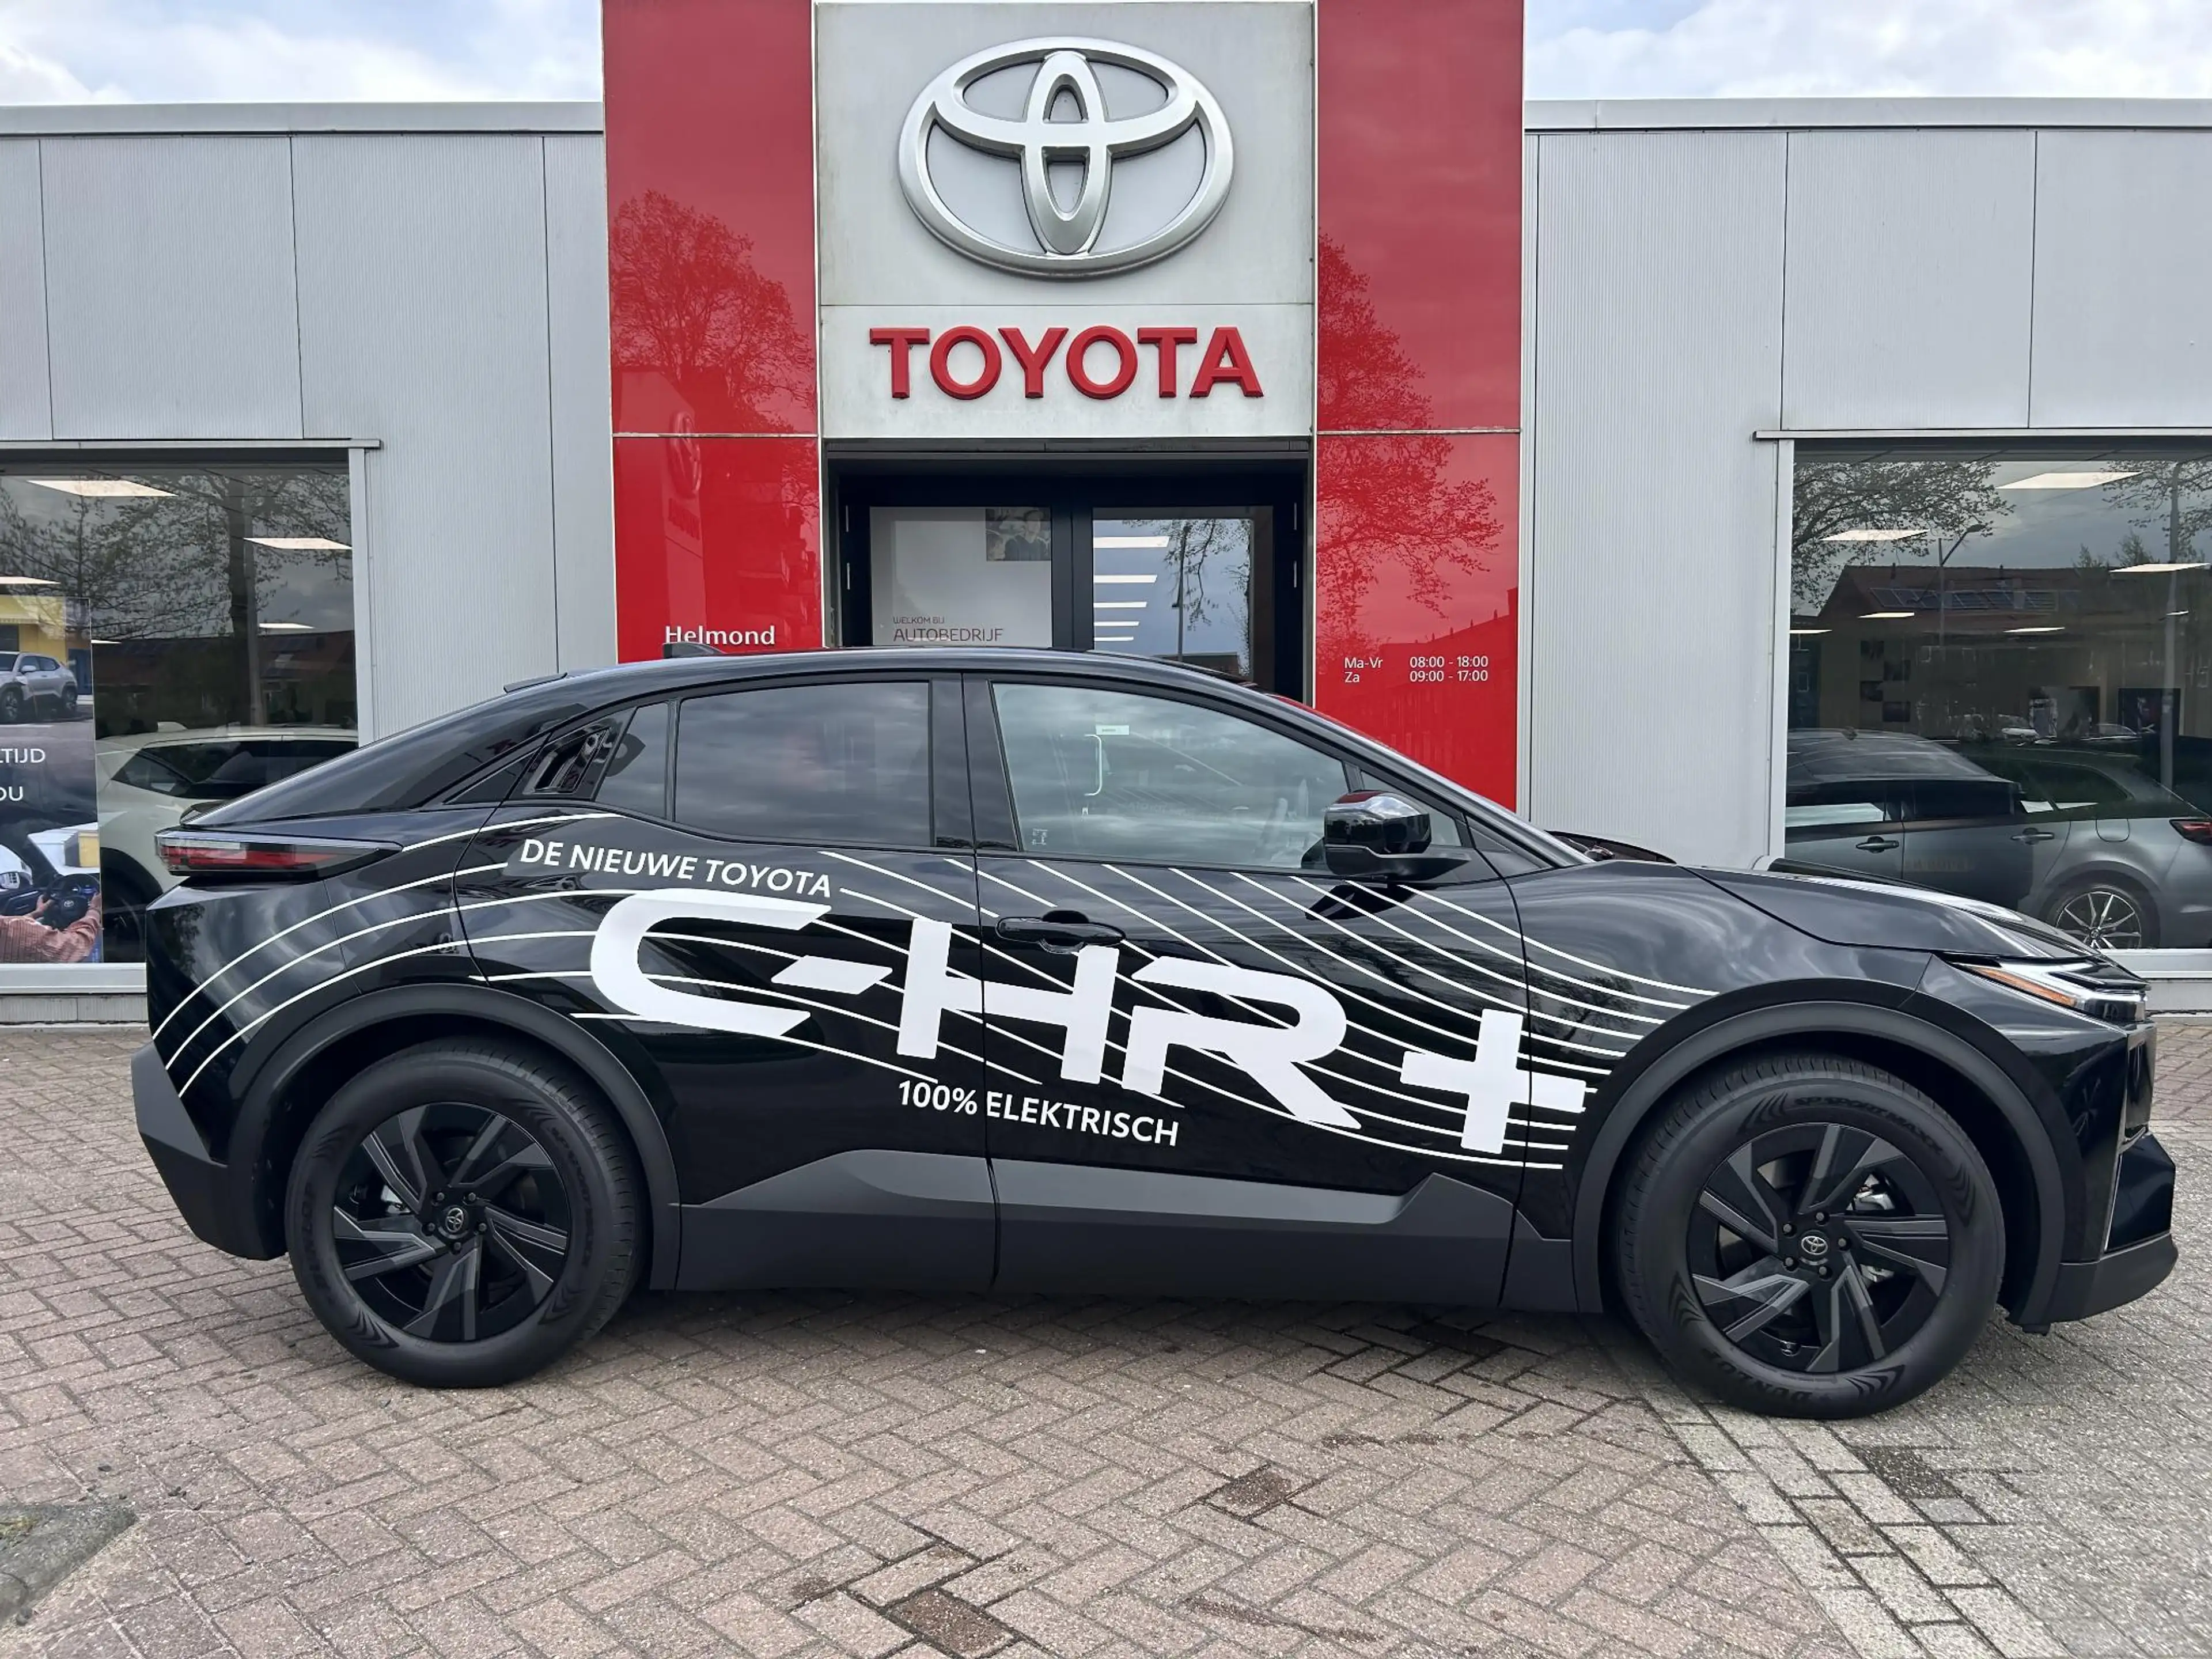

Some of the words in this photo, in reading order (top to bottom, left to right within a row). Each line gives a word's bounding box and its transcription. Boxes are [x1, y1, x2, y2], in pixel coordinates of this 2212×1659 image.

[869, 326, 1263, 400] TOYOTA
[665, 626, 775, 645] Helmond
[893, 628, 1003, 642] AUTOBEDRIJF
[1344, 657, 1383, 668] Ma-Vr
[1410, 656, 1445, 668] 08:00
[1457, 656, 1488, 668] 18:00
[1344, 672, 1360, 683] Za
[1410, 671, 1445, 682] 09:00
[1457, 670, 1488, 682] 17:00
[520, 838, 565, 866] DE
[568, 844, 699, 881] NIEUWE
[704, 858, 831, 898] TOYOTA
[897, 1080, 978, 1115] 100%
[986, 1090, 1179, 1147] ELEKTRISCH
